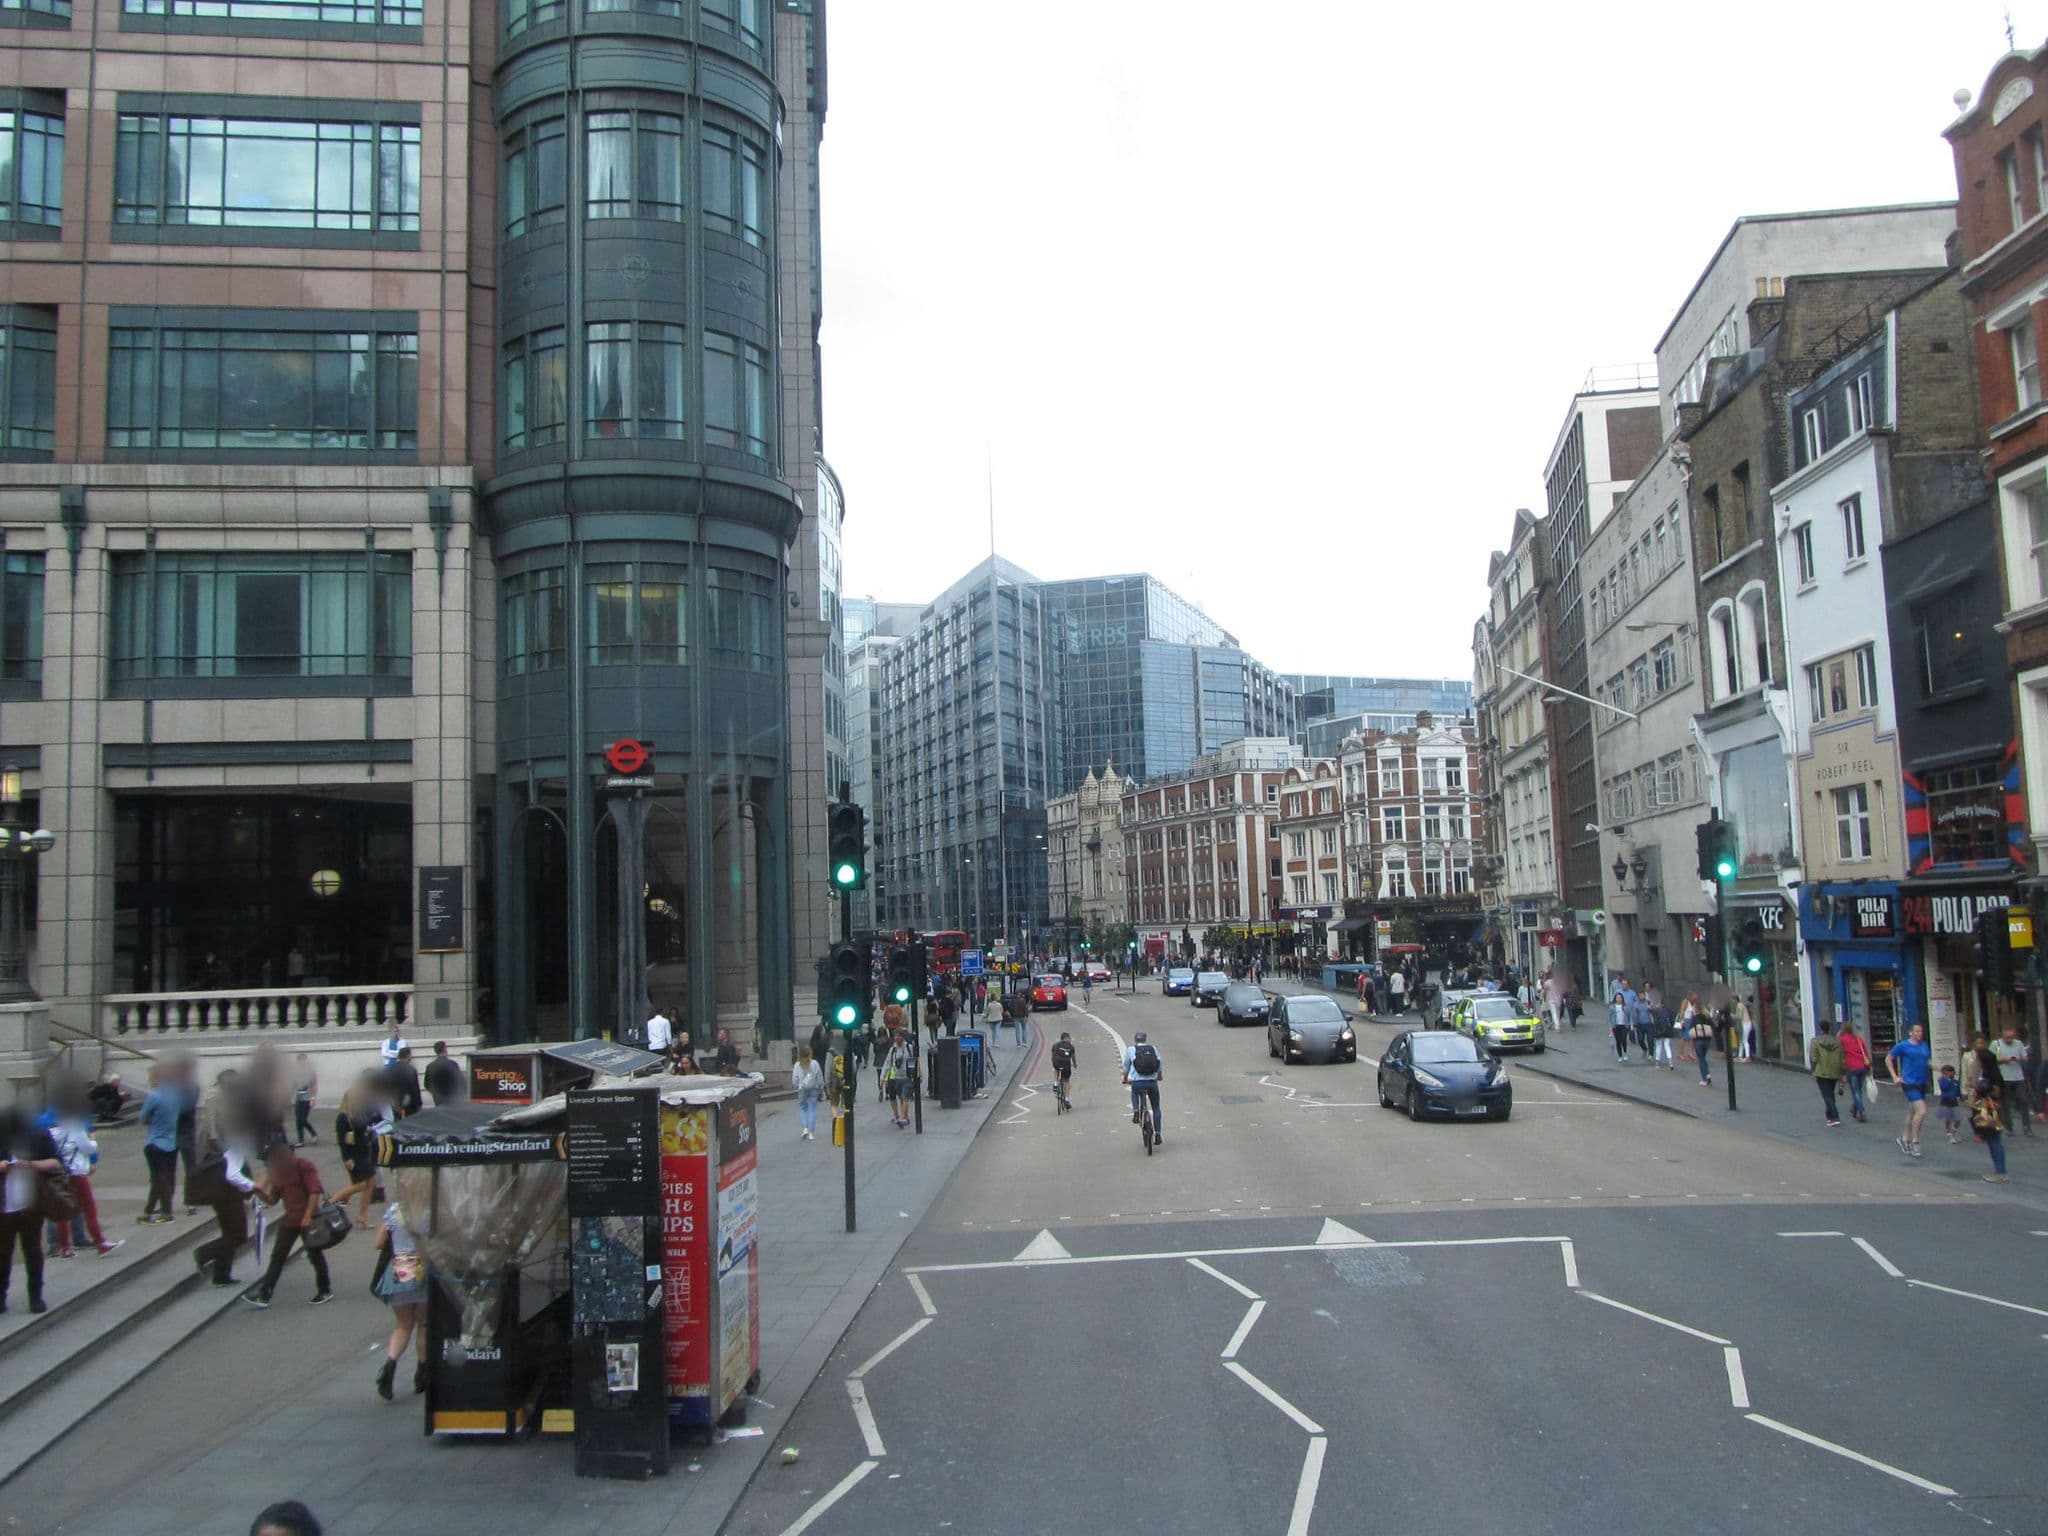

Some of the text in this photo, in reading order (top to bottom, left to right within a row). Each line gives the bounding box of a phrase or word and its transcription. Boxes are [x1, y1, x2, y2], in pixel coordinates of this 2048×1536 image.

[1091, 625, 1127, 647] RBS
[1857, 897, 1888, 913] POLO
[1759, 906, 1784, 929] KFC
[1860, 912, 1886, 927] BAR
[1931, 896, 1973, 933] POLO
[474, 1068, 515, 1081] Tanning
[498, 1079, 526, 1092] Shop
[614, 1095, 635, 1103] Station
[663, 1216, 694, 1233] IPS
[666, 1248, 688, 1257] WALK
